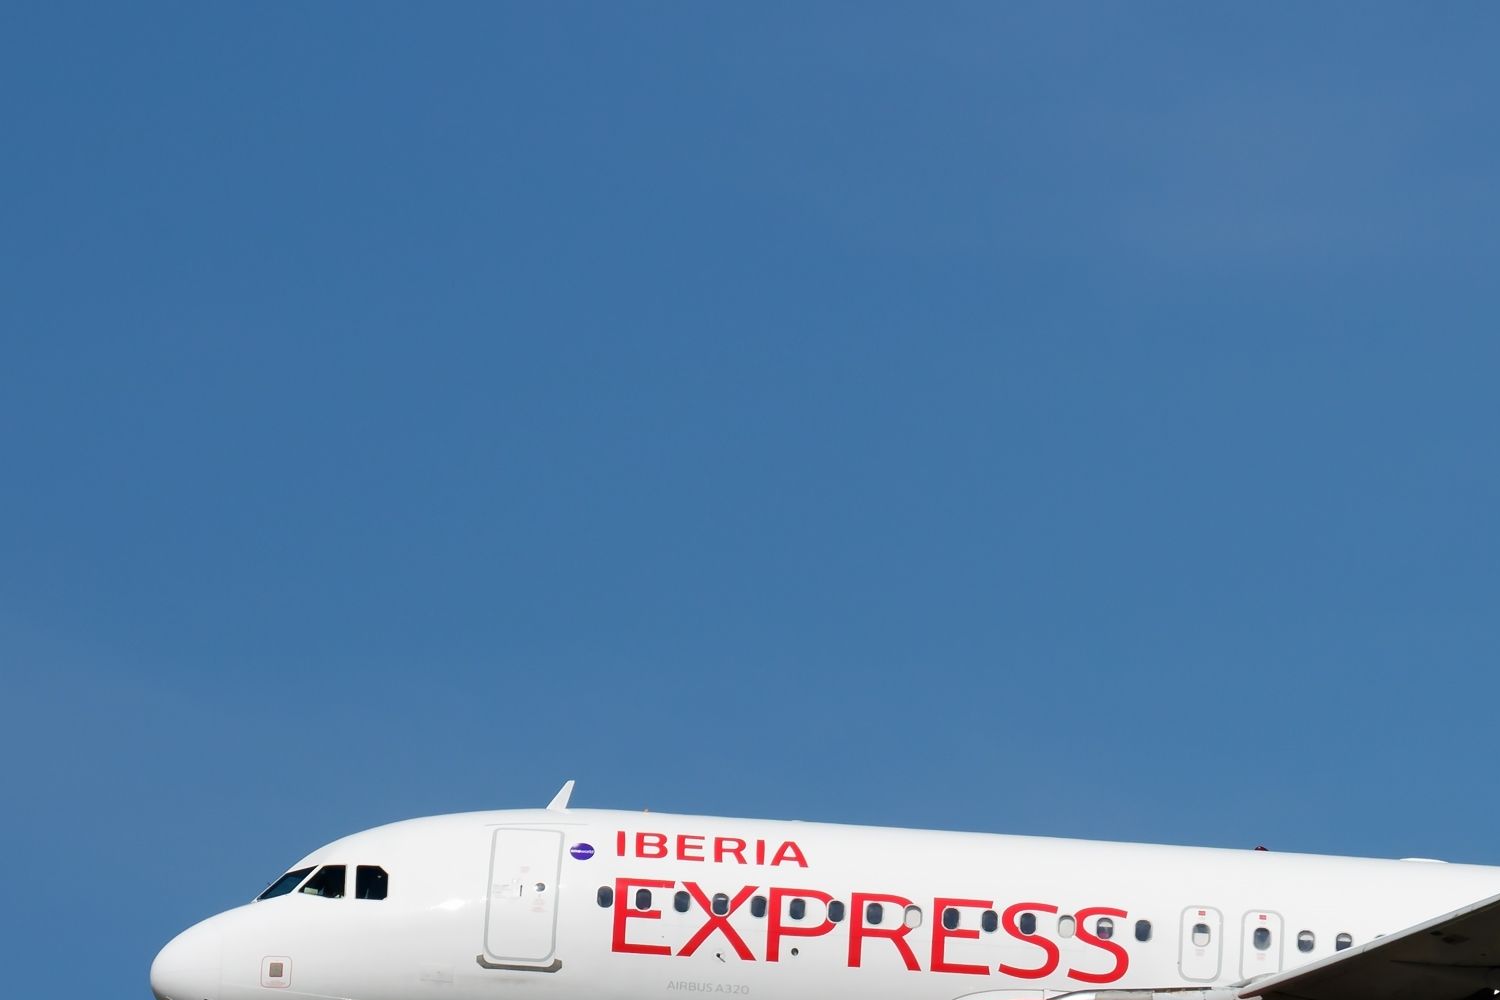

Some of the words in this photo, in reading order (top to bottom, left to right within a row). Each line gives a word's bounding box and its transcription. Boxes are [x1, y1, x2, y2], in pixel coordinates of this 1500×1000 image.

[616, 831, 808, 868] IBERIA
[611, 877, 1129, 984] EXPRESS
[666, 980, 713, 993] AIRBUS
[715, 983, 750, 995] A320
